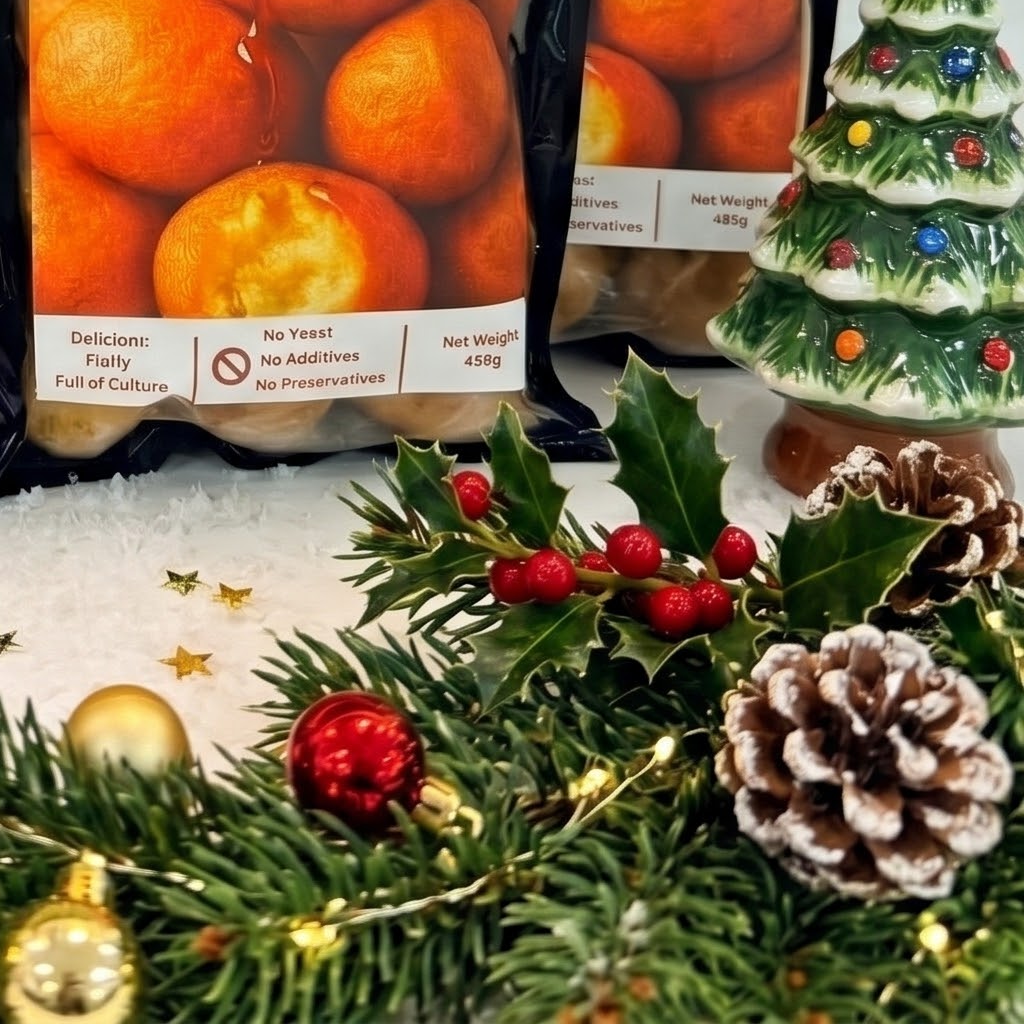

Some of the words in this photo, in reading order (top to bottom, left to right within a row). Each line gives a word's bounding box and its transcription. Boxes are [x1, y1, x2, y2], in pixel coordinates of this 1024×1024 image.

[691, 193, 717, 206] Net
[720, 195, 768, 210] Weight
[263, 329, 285, 342] No
[443, 336, 469, 349] Net
[473, 329, 519, 347] Weight
[261, 354, 282, 367] No
[286, 350, 360, 366] Additives
[464, 354, 501, 369] 458g
[55, 375, 84, 388] Full
[88, 377, 105, 389] of
[108, 377, 169, 393] Culture
[256, 379, 277, 391] No
[281, 372, 386, 390] Preservatives
